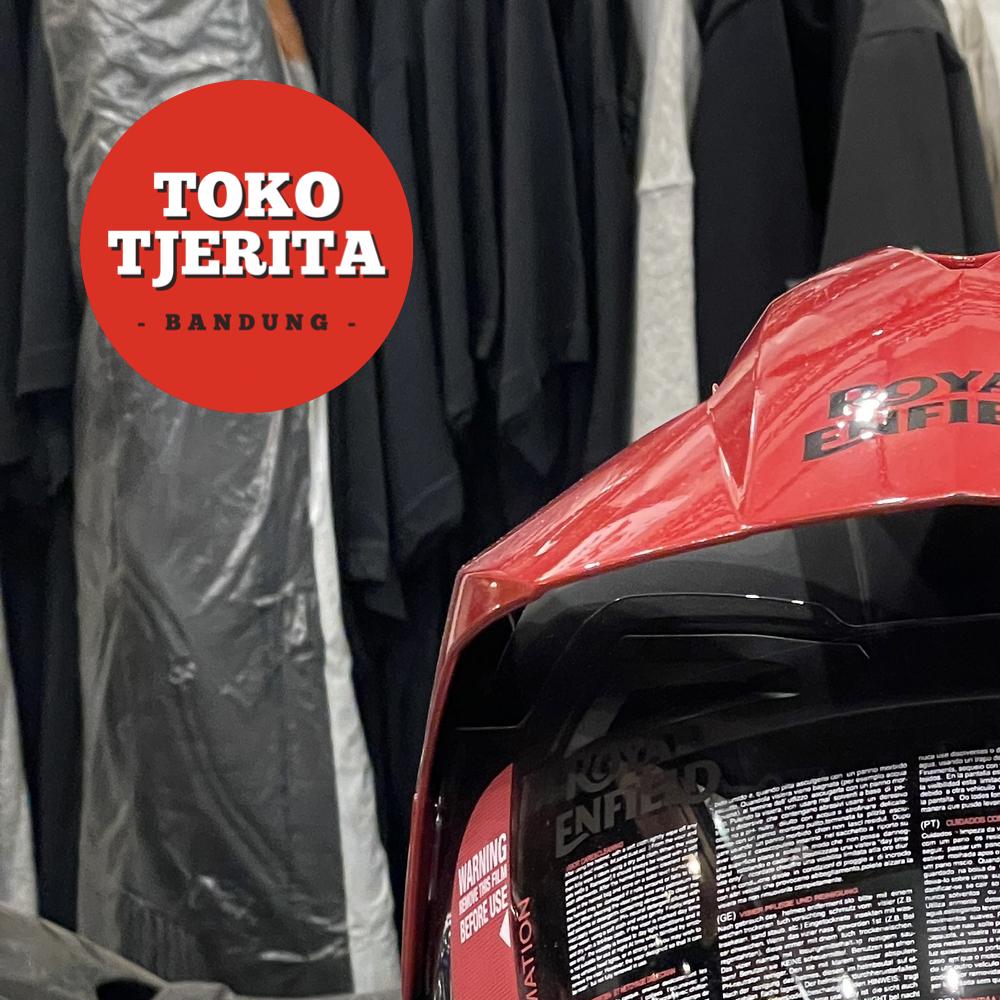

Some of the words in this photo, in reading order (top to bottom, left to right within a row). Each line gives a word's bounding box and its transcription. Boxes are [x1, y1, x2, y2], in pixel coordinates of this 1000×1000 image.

[556, 760, 722, 858] ENFIELD
[920, 818, 941, 831] (PT)
[458, 832, 508, 896] WARNING
[491, 863, 508, 888] FILM
[460, 899, 489, 944] BEFORE
[489, 885, 509, 919] USE
[717, 910, 736, 926] (GE)
